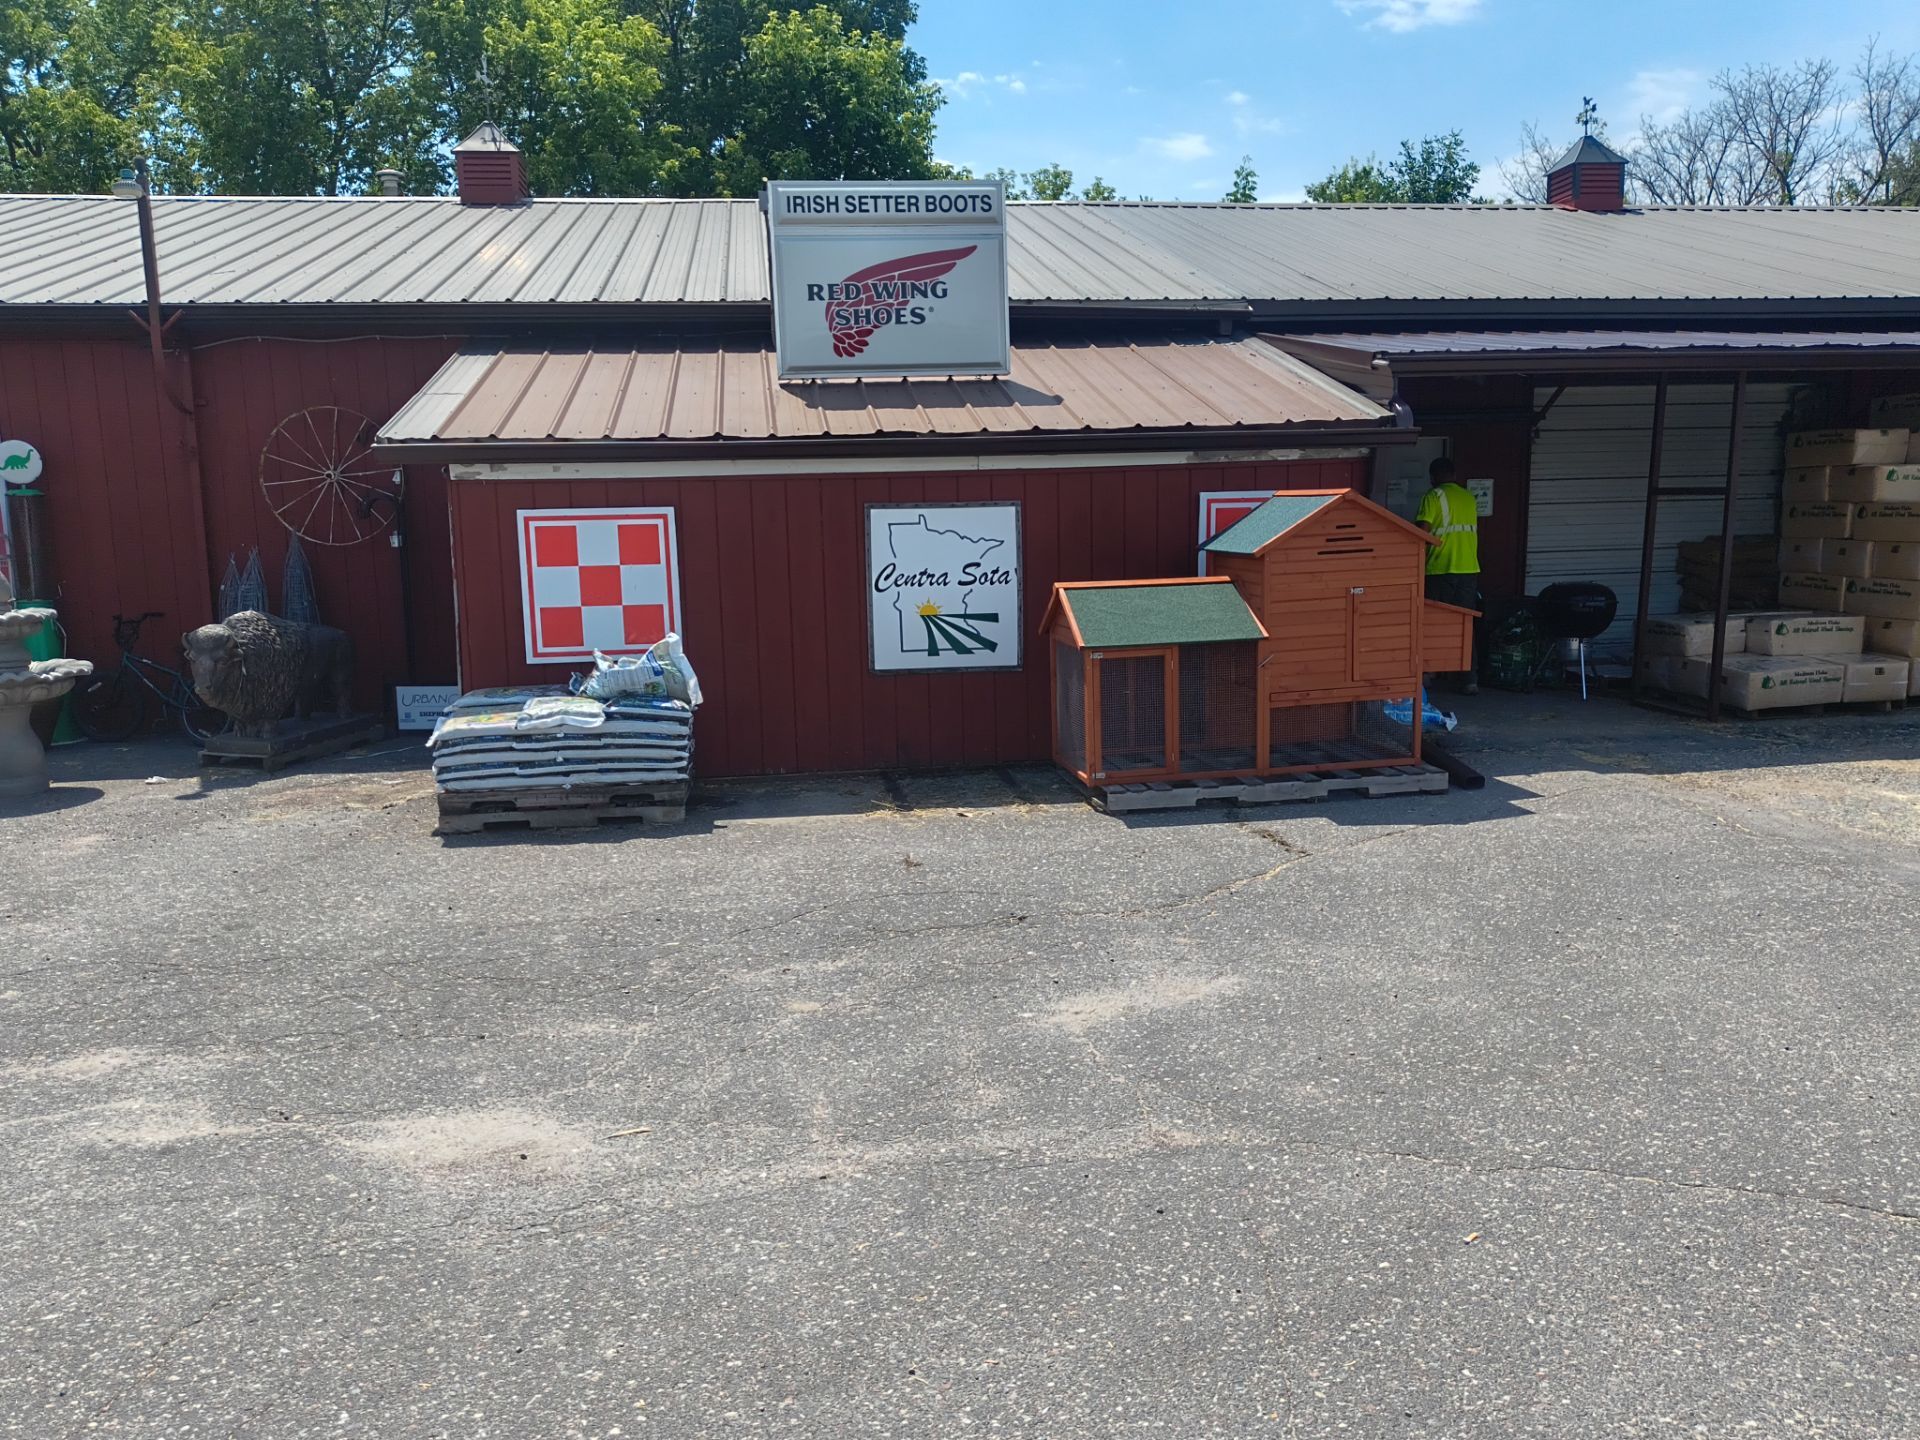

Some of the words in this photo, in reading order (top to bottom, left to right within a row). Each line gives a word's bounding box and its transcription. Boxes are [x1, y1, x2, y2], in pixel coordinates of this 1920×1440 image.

[786, 195, 839, 213] IRISH
[845, 195, 920, 213] SETTER
[925, 194, 993, 213] BOOTS
[807, 283, 862, 301] RED
[870, 280, 948, 299] WING
[835, 306, 927, 325] SHOES
[874, 562, 951, 593] Centra
[957, 562, 1012, 586] Sota
